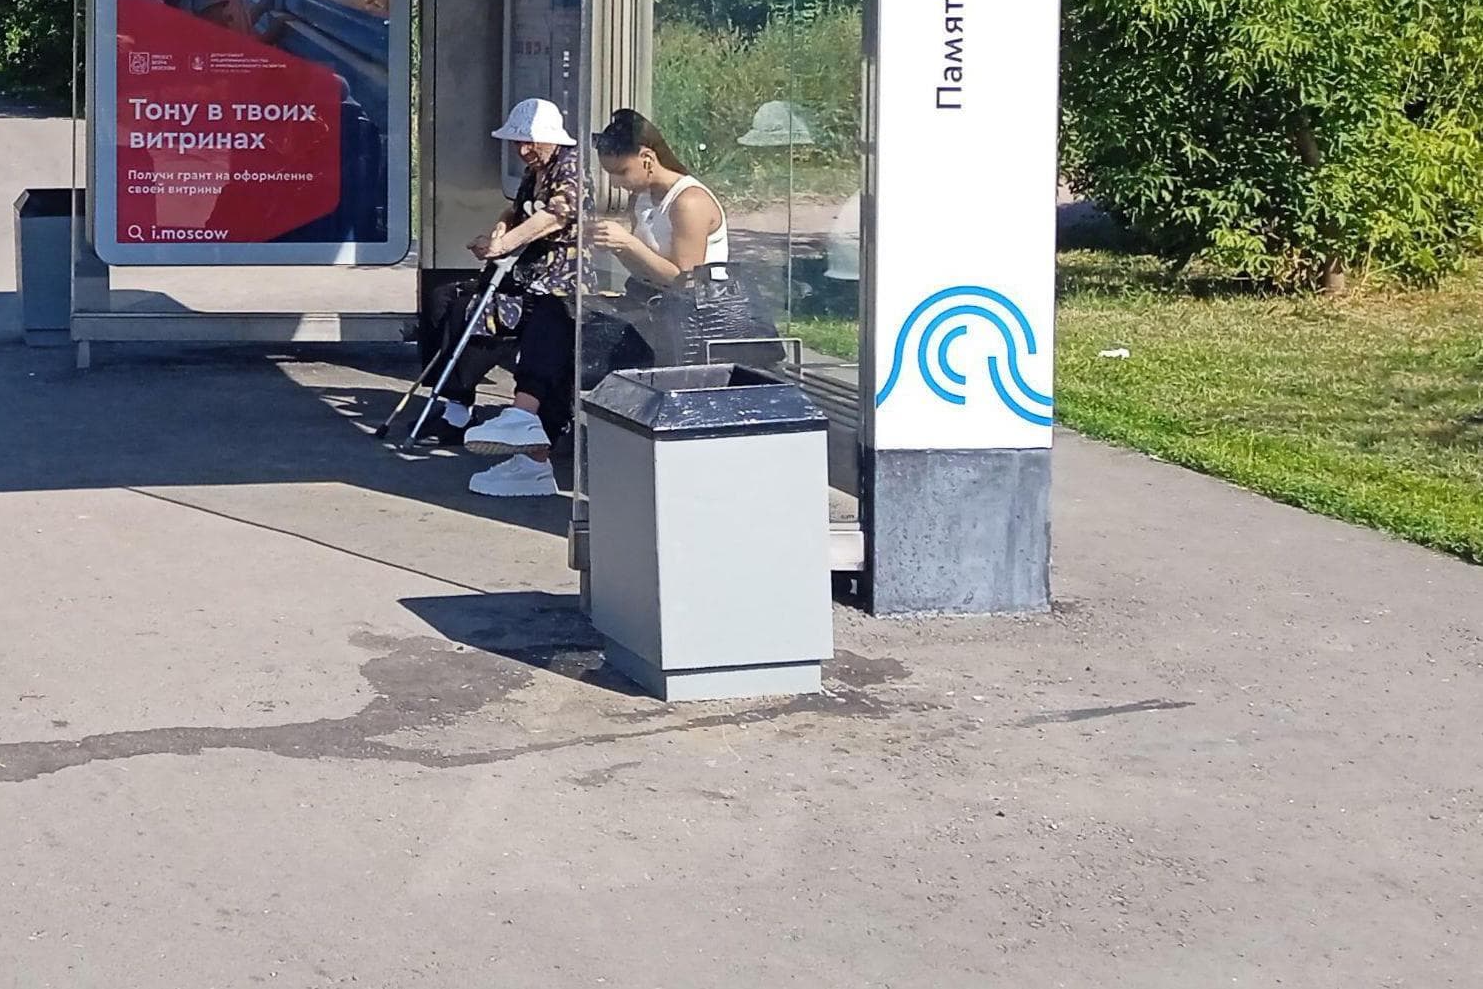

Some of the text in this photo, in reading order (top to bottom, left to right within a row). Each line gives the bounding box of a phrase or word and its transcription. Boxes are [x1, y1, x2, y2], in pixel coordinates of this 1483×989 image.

[128, 98, 316, 126] Тону в твоих
[129, 131, 266, 154] витринах
[128, 169, 314, 182] Получи грант на оформление
[127, 182, 223, 196] своей витрины
[151, 225, 229, 240] i.moscow
